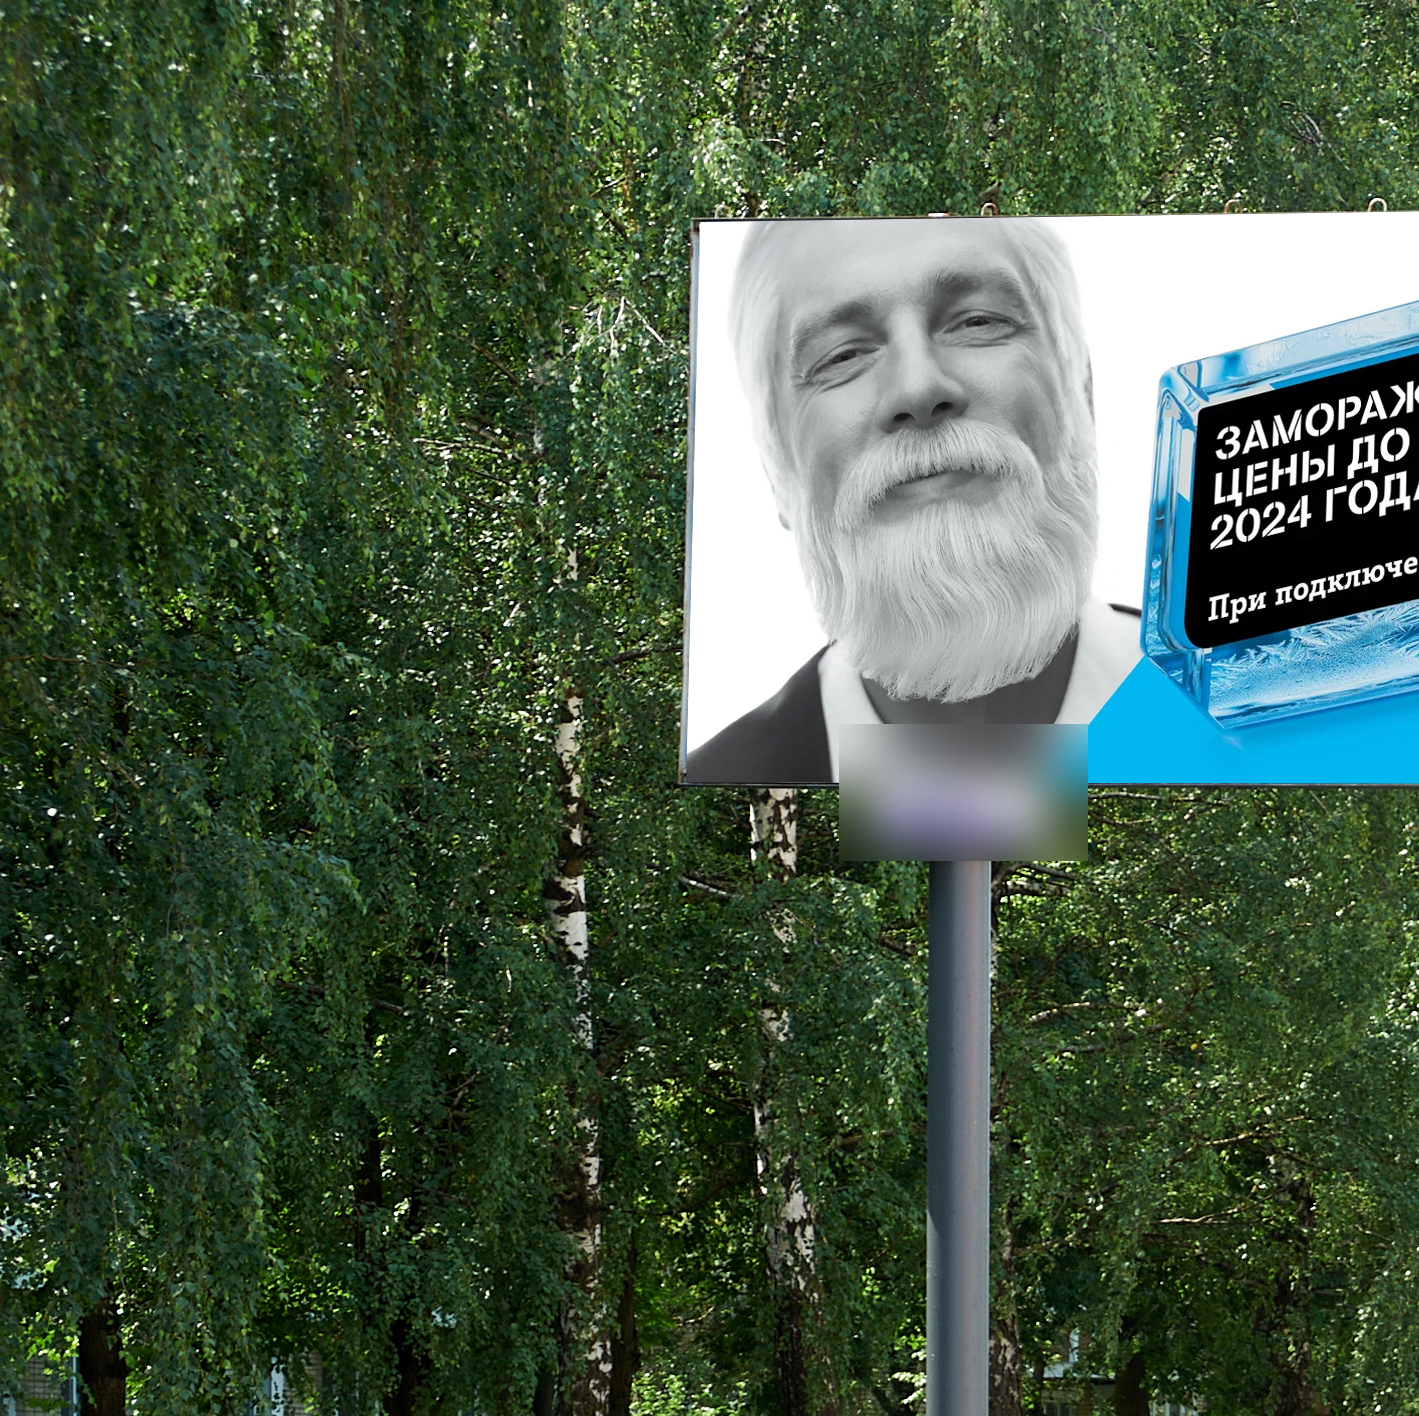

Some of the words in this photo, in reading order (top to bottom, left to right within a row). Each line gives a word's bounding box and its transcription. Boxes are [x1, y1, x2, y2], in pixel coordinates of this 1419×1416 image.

[1213, 443, 1336, 507] ЦЕНЫ
[1346, 427, 1410, 480] ДО
[1210, 495, 1312, 550] 2024
[1207, 591, 1267, 625] При
